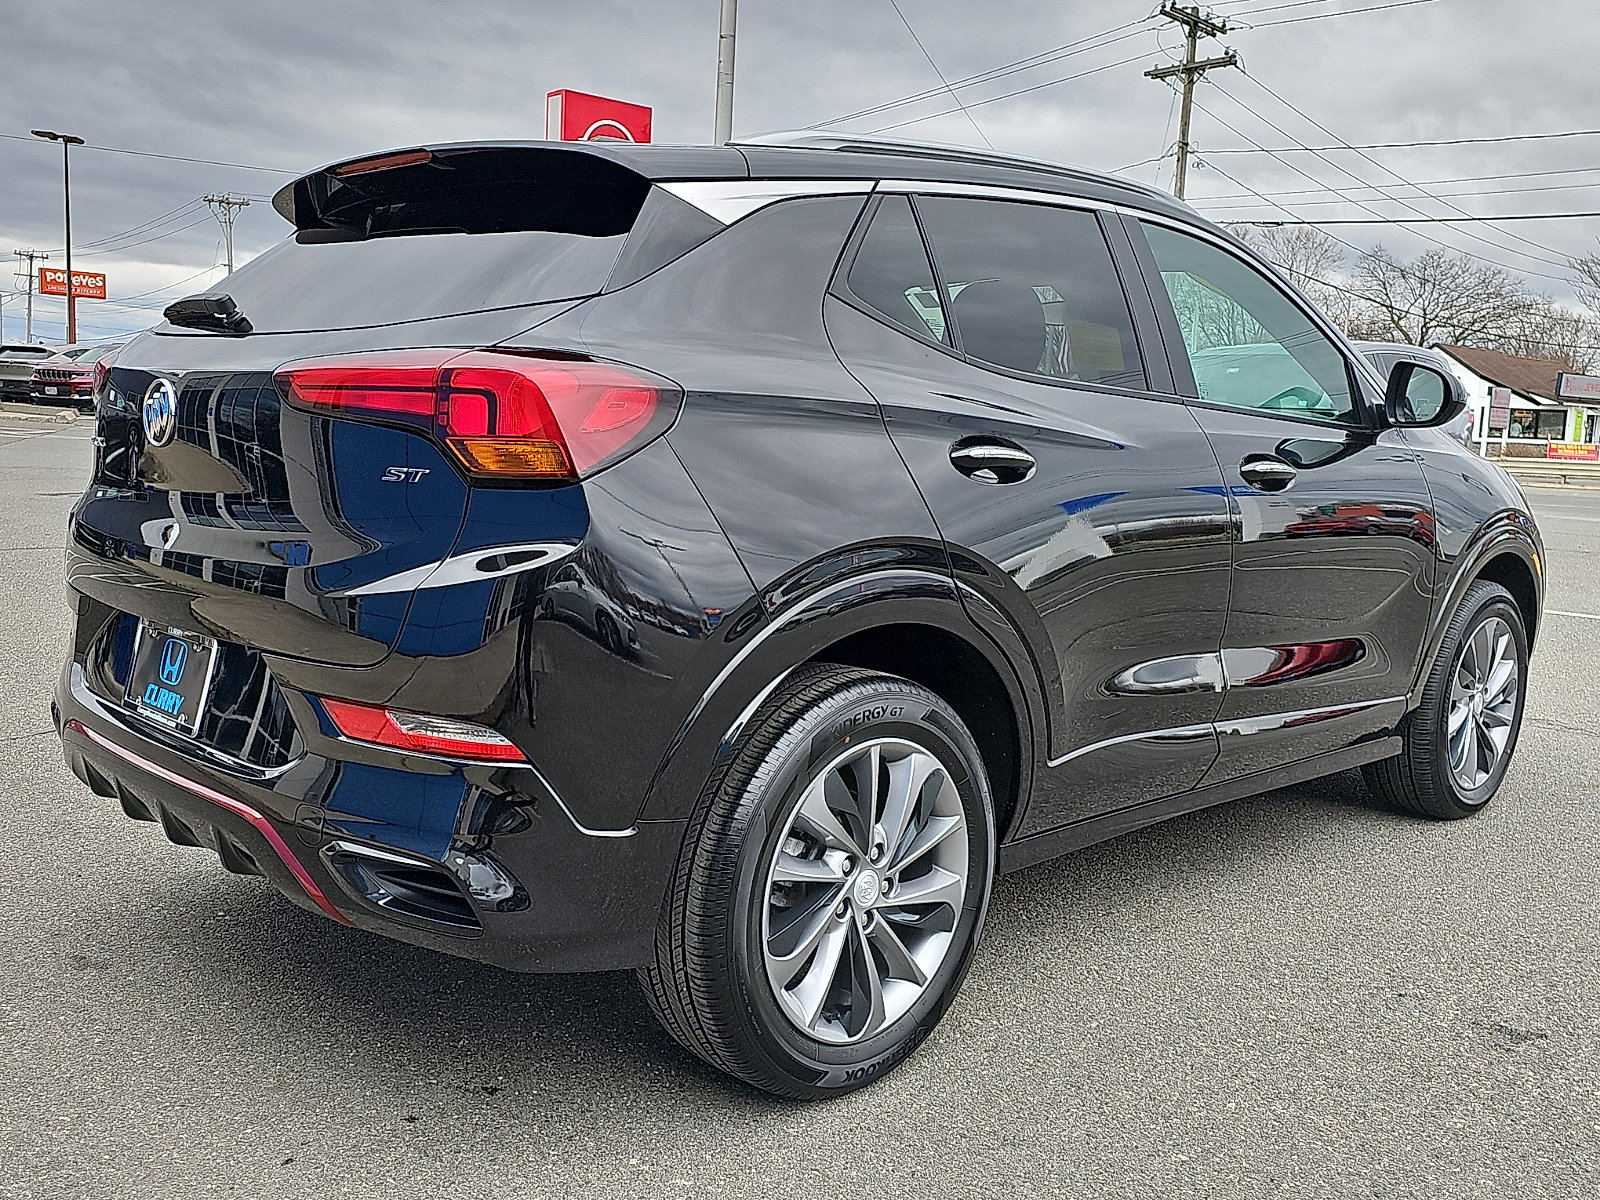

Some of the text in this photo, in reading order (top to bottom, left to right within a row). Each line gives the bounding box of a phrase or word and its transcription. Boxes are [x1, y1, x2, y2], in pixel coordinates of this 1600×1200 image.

[381, 466, 431, 483] ST
[143, 683, 185, 716] CURRY
[889, 706, 905, 717] GT
